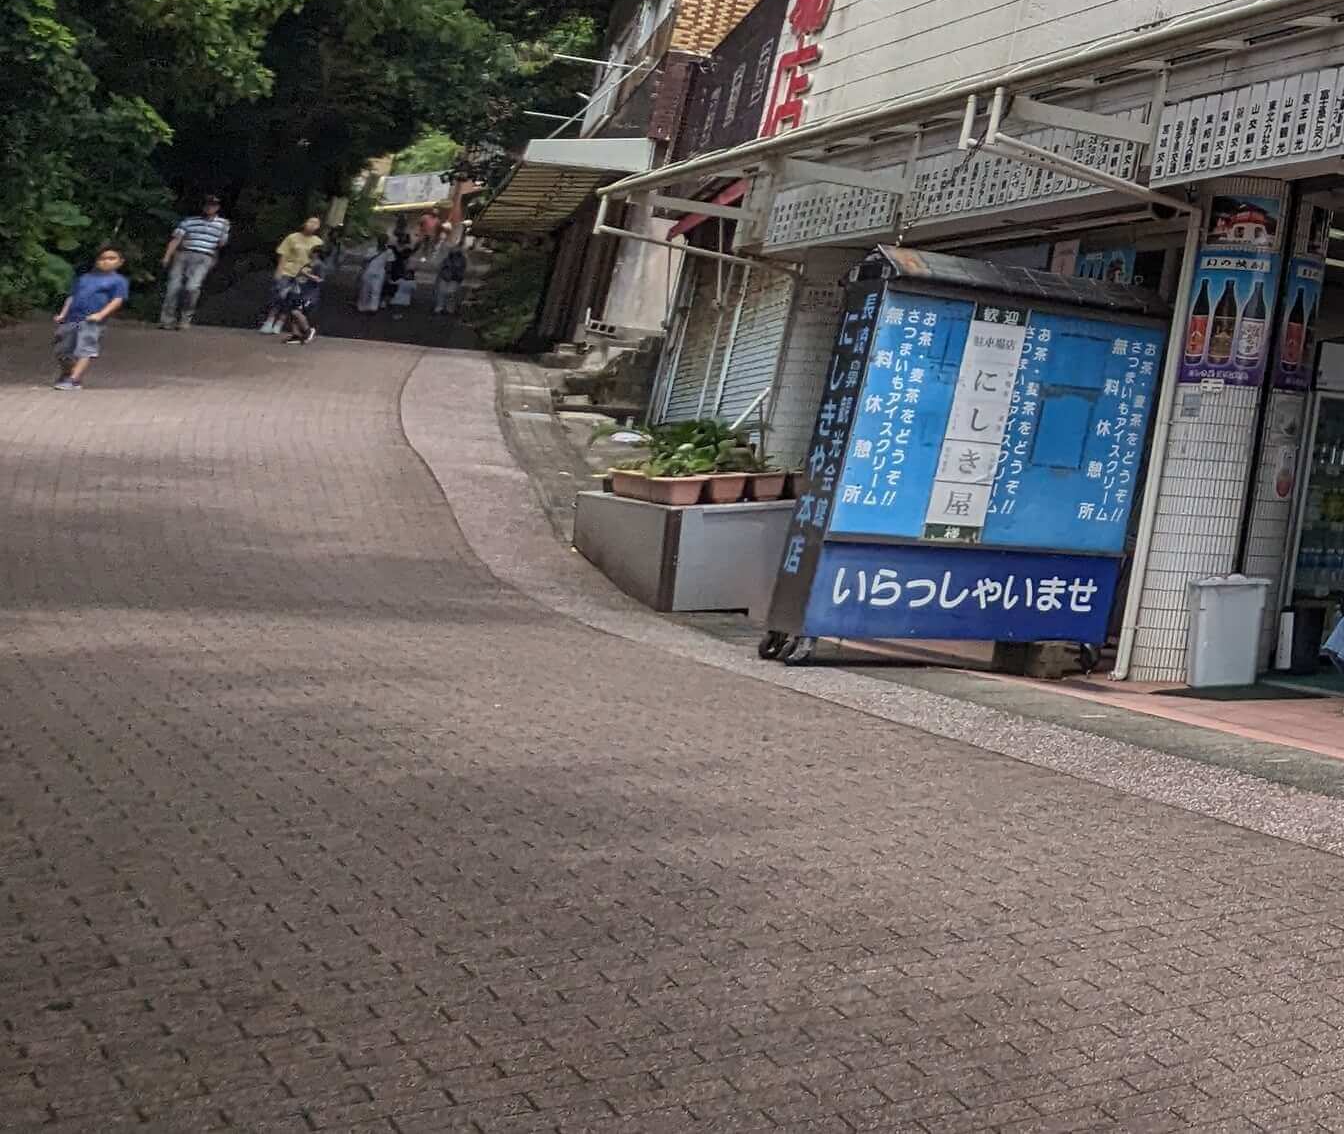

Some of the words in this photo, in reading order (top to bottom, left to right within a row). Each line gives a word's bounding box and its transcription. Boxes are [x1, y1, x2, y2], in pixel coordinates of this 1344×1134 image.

[841, 306, 904, 506] 無料休憩所
[983, 307, 1020, 324] 歓迎
[784, 311, 860, 574] にしきや本店
[862, 309, 920, 506] さつまいもアイスクリーム
[944, 368, 998, 517] にしき屋
[1076, 337, 1129, 519] 無料休憩所
[1094, 341, 1143, 522] さつまいもアイスクリーム
[831, 567, 1098, 613] いらっしゃいませ
